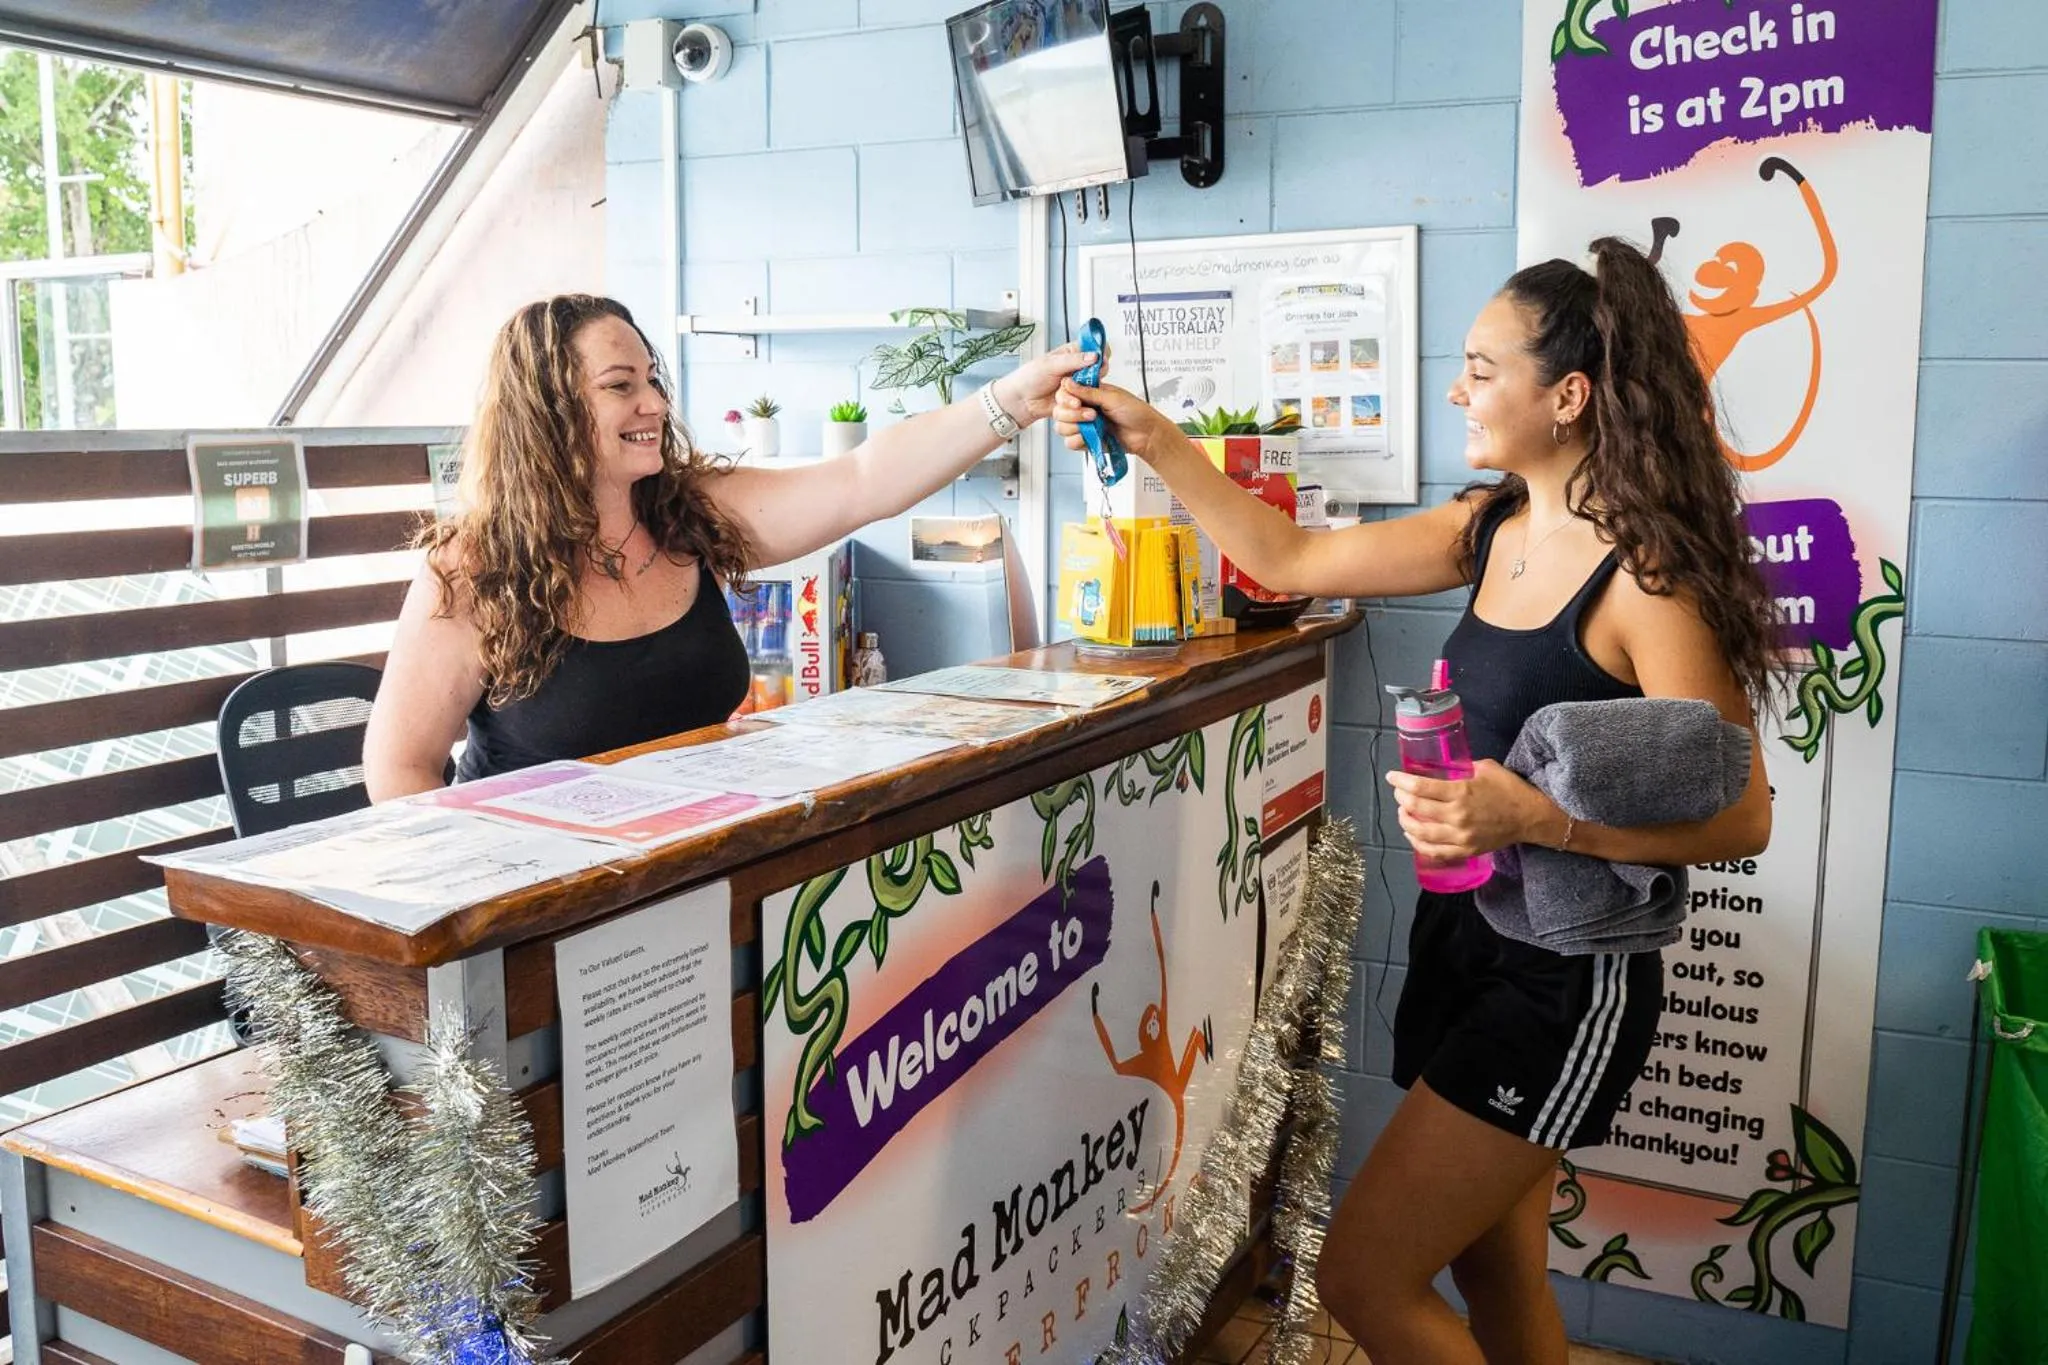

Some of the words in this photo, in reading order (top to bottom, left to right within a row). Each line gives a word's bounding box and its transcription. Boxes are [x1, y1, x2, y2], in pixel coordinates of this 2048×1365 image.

[1630, 9, 1777, 70] Check
[1792, 4, 1835, 45] in
[1628, 96, 1664, 135] is
[1676, 87, 1725, 128] at
[1740, 76, 1844, 126] 2pm
[1123, 308, 1164, 323] WANT
[1167, 308, 1185, 321] TO
[1190, 306, 1225, 321] STAY
[1124, 323, 1138, 336] IN
[1142, 321, 1225, 336] AUSTRALIA?
[1152, 338, 1181, 352] CAN
[1186, 336, 1220, 351] HELP
[1264, 450, 1292, 467] FREE
[224, 471, 278, 486] SUPERB
[1686, 887, 1763, 914] ption
[1690, 928, 1741, 951] you
[627, 984, 641, 996] have
[642, 978, 656, 990] been
[658, 967, 679, 983] advised
[1672, 962, 1725, 986] out,
[1733, 970, 1765, 988] so
[582, 988, 601, 1002] Please
[584, 1012, 604, 1028] weekly
[846, 951, 1038, 1129] Welcome
[1049, 917, 1083, 972] to
[1695, 1030, 1767, 1061] know
[645, 1074, 660, 1087] know
[1679, 1064, 1743, 1095] beds
[1639, 1096, 1765, 1140] changing
[875, 1222, 984, 1365] Mad
[991, 1098, 1150, 1273] Monkey
[940, 1168, 1147, 1365] CKPACKERS
